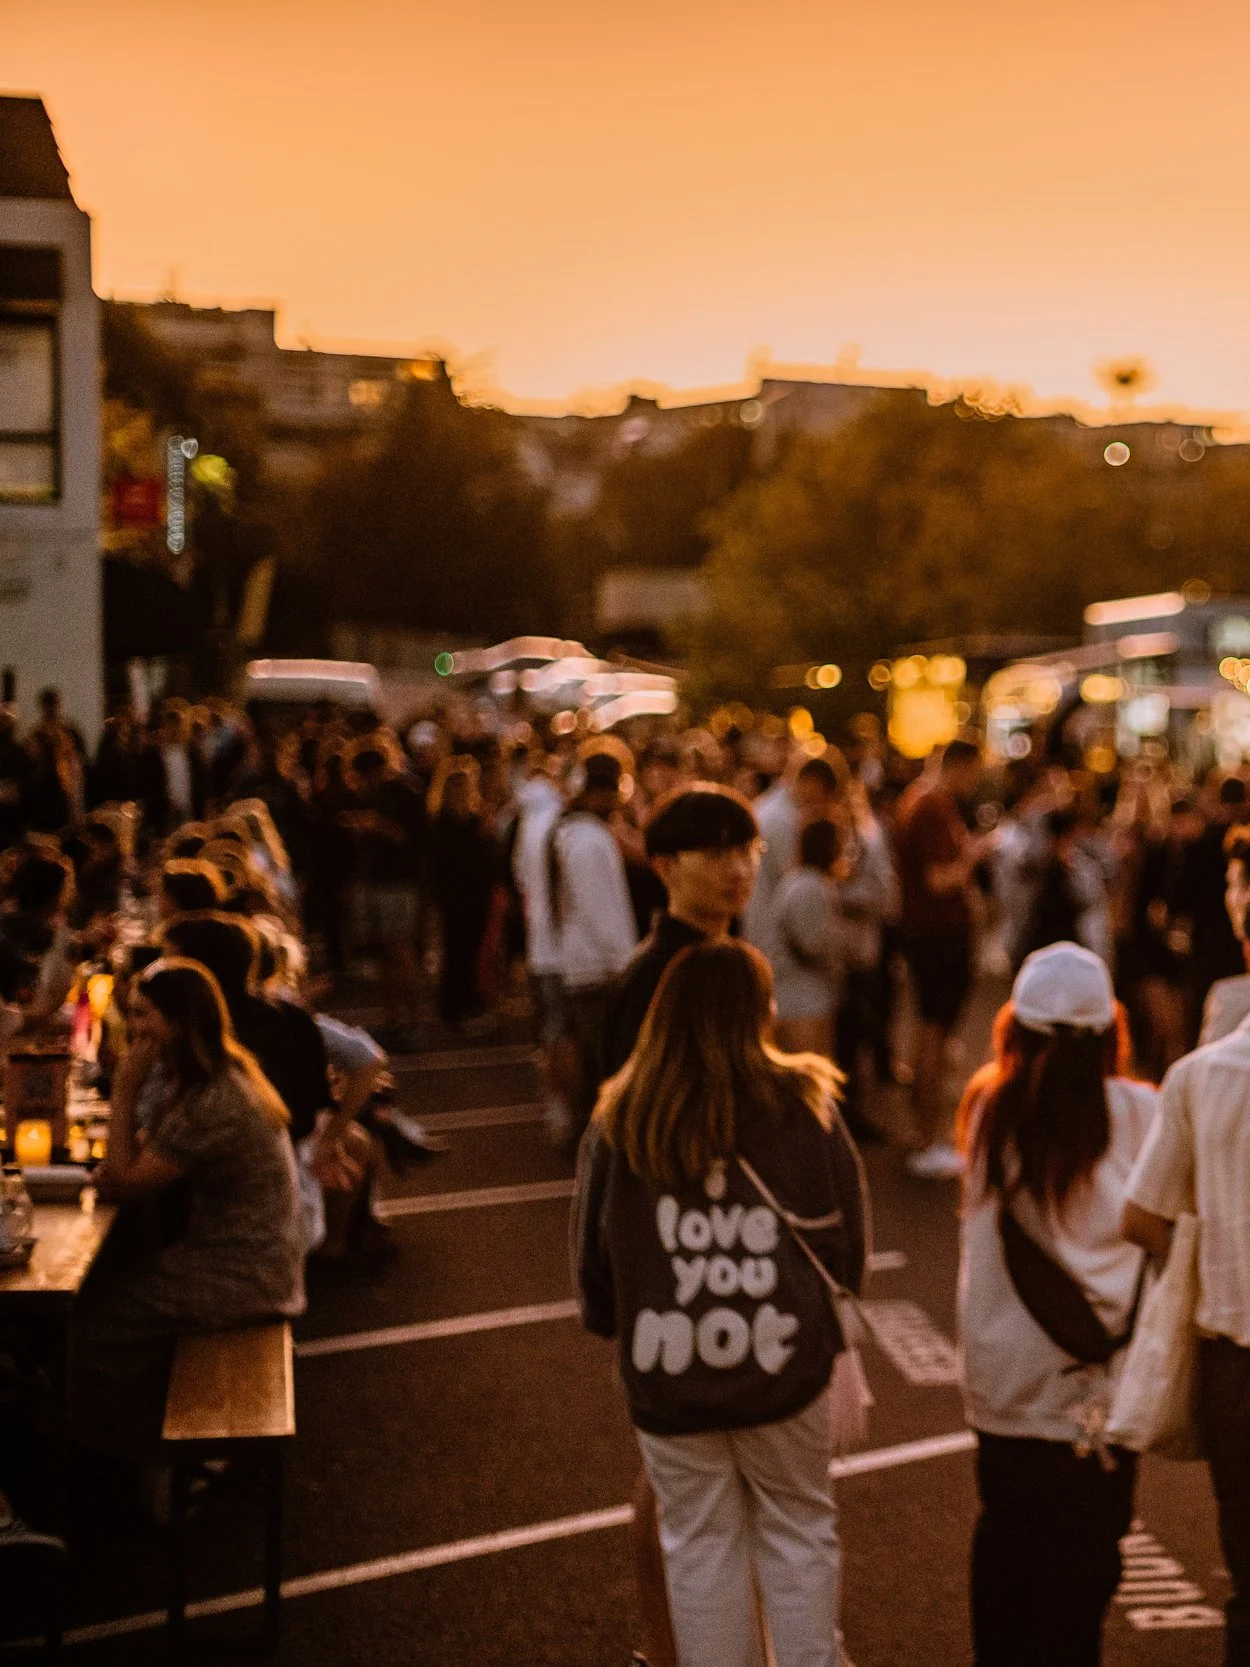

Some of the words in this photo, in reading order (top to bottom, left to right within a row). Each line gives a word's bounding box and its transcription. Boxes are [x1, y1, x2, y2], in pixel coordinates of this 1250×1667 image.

[656, 1195, 779, 1254] love
[671, 1255, 778, 1306] you
[632, 1304, 799, 1375] not
